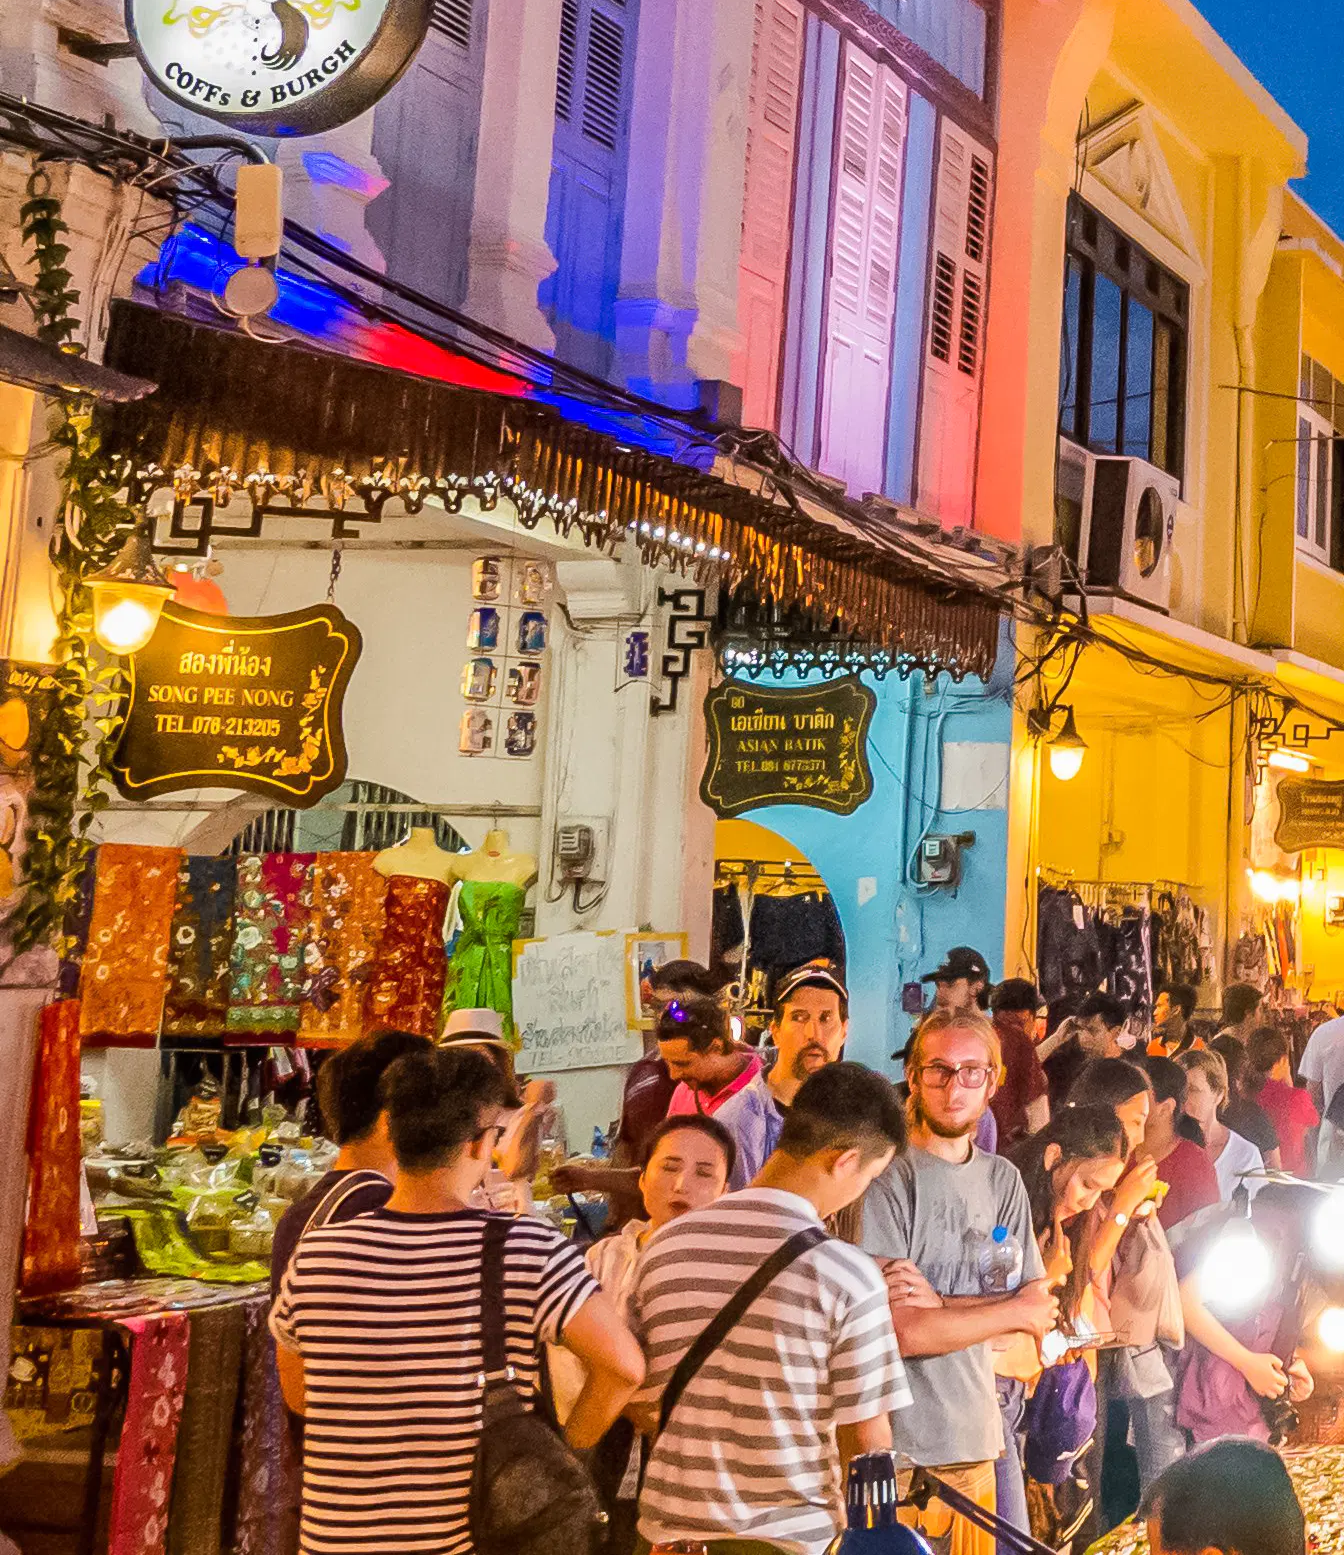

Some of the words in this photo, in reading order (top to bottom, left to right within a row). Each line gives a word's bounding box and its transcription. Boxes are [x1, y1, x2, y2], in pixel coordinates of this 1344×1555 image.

[240, 89, 261, 108] &
[270, 40, 357, 105] BURGH
[178, 639, 273, 677] สองพี่น้อง
[147, 684, 198, 705] SONG
[202, 686, 235, 706] PEE
[241, 689, 295, 708] NONG
[737, 737, 778, 752] ASIAN
[784, 737, 826, 751] BATIK
